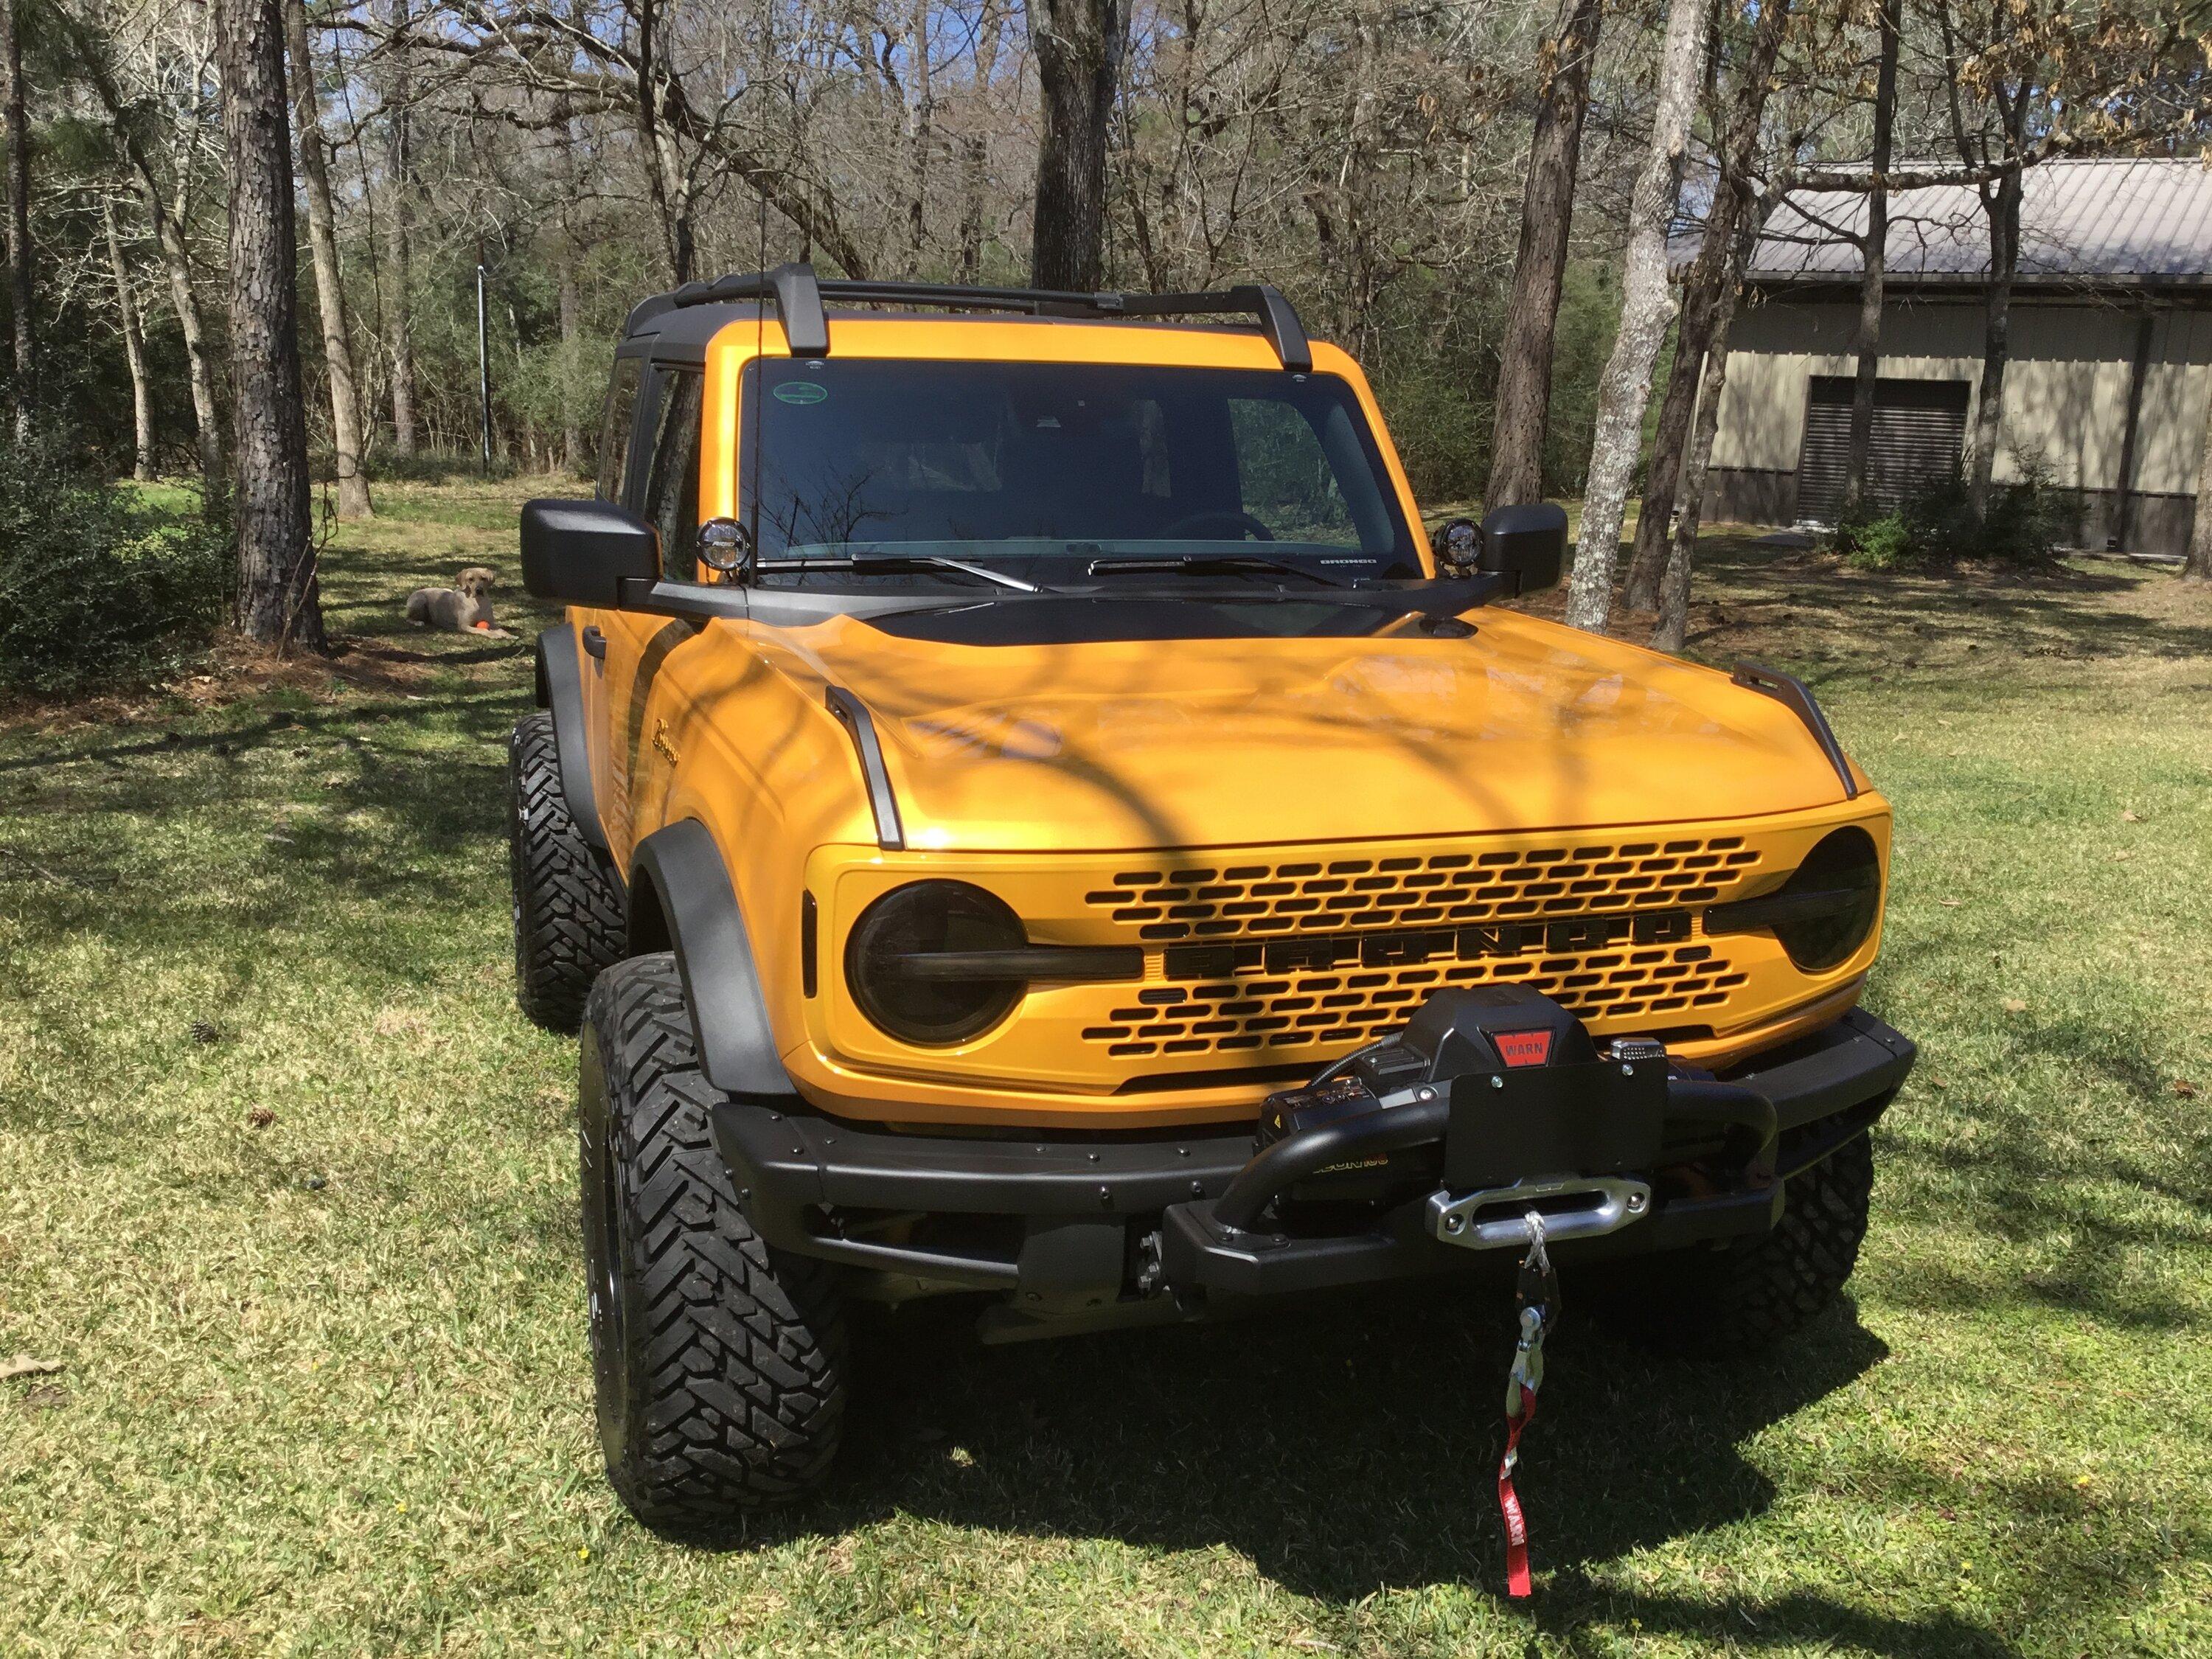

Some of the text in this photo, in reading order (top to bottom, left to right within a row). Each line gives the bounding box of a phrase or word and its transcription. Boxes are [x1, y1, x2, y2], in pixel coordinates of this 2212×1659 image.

[1164, 912, 1693, 980] BRONCO
[1506, 1043, 1543, 1056] WARN
[1505, 1496, 1524, 1546] WARN
